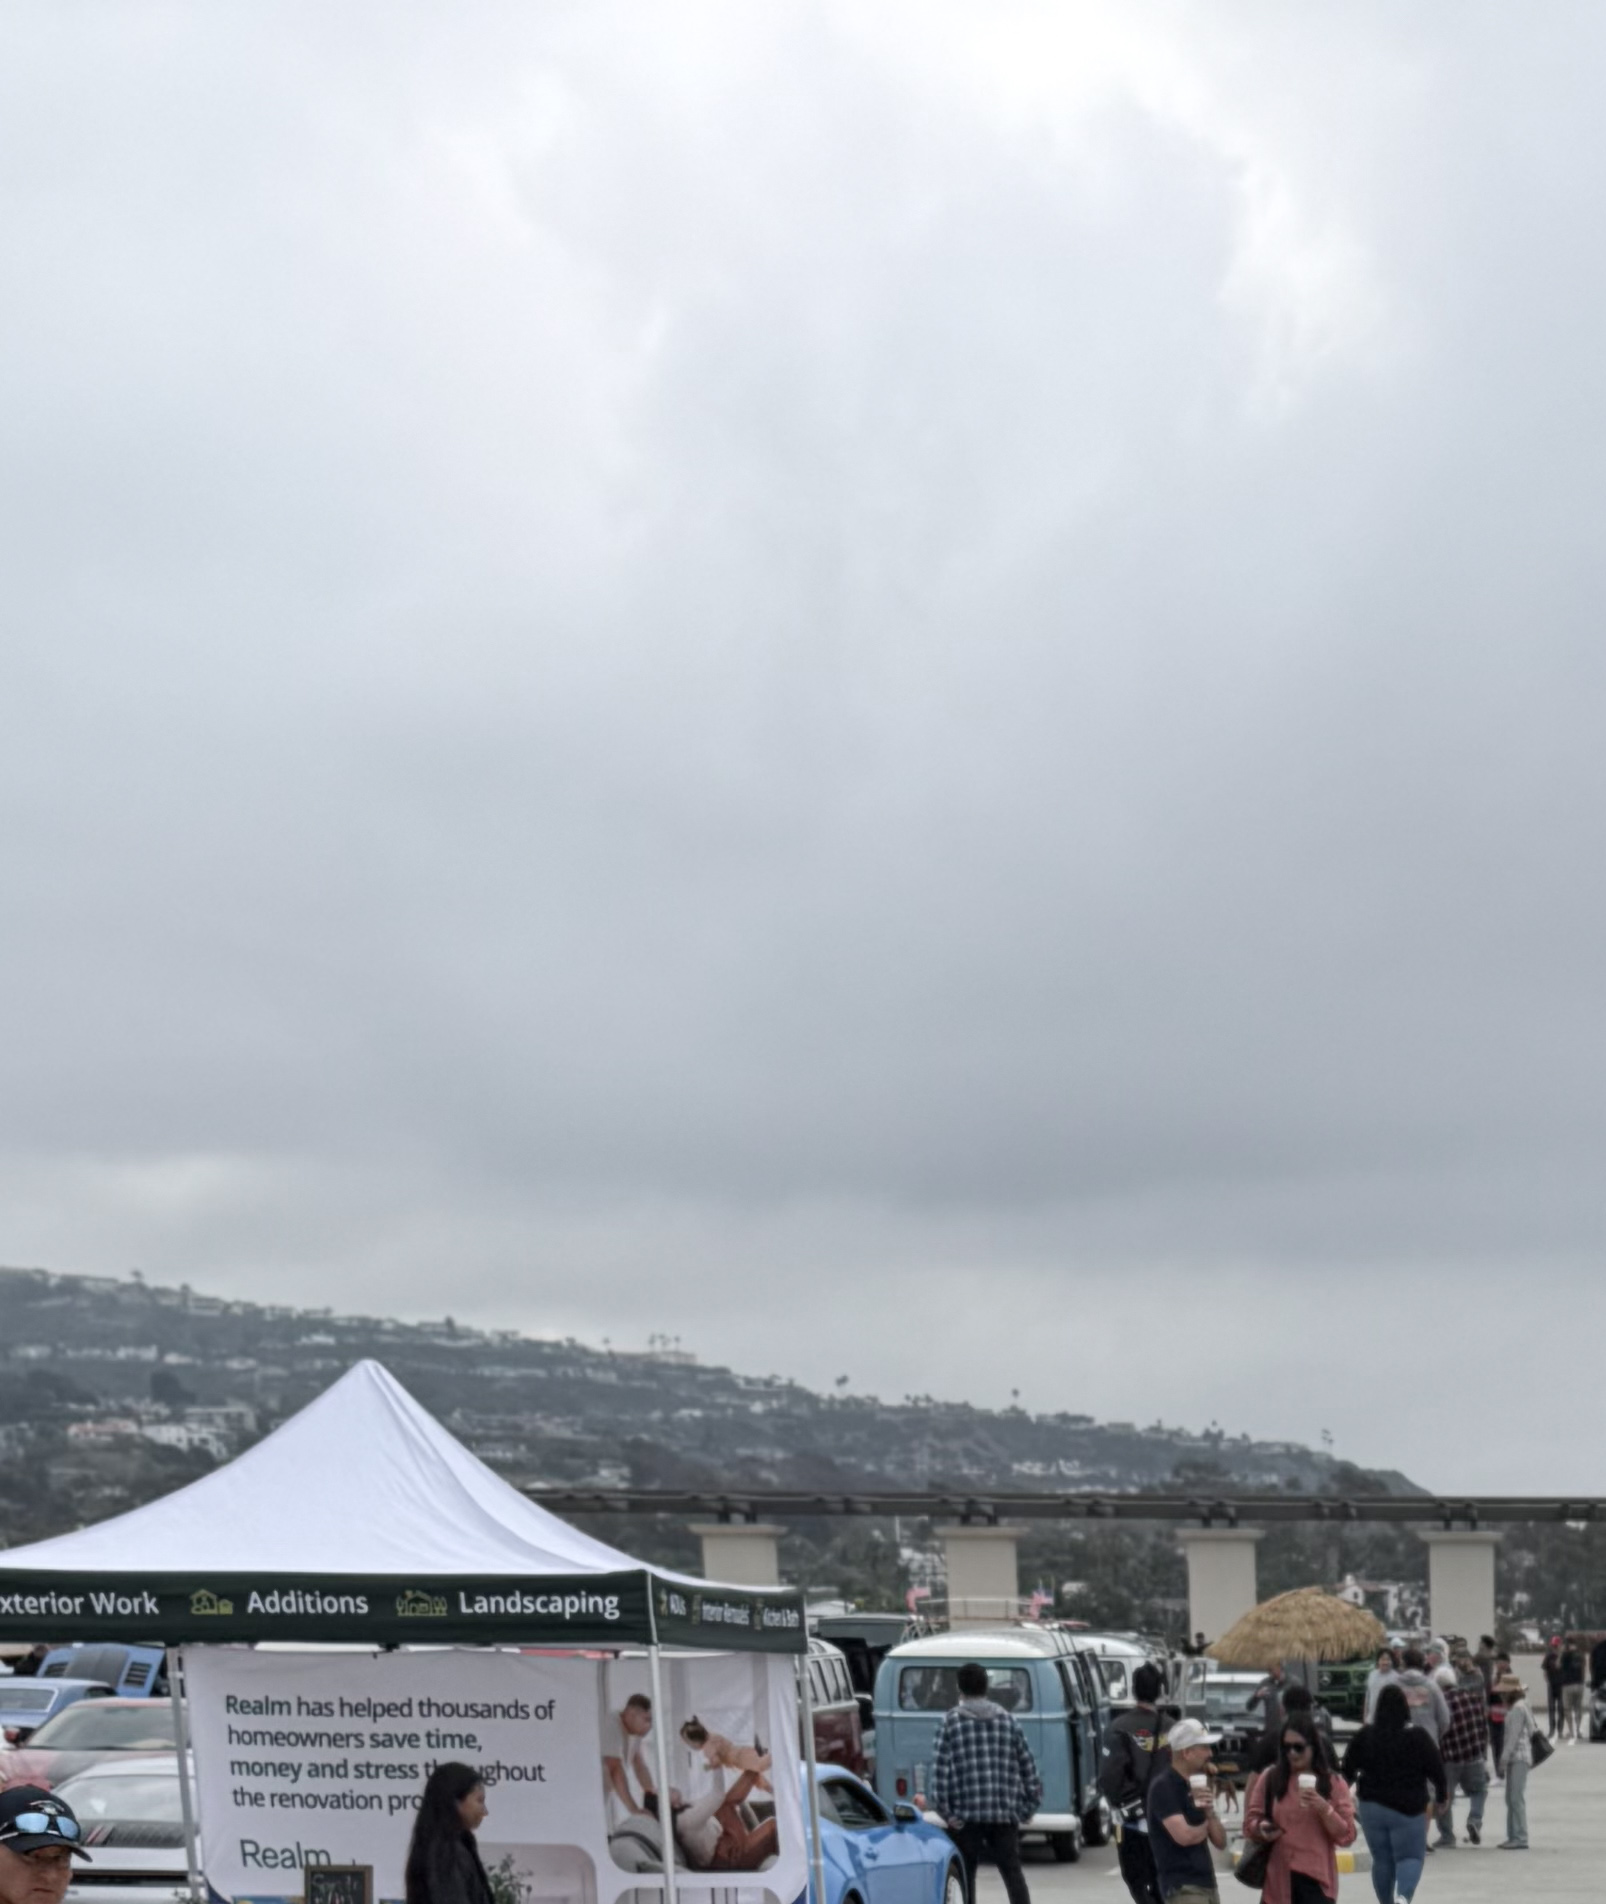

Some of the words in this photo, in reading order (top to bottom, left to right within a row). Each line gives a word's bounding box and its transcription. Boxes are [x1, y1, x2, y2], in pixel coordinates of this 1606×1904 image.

[0, 1591, 84, 1615] xterior
[89, 1592, 160, 1615] Work
[247, 1590, 369, 1615] Additions
[459, 1591, 620, 1620] Landscaping
[226, 1695, 292, 1716] Realm
[297, 1696, 335, 1717] has
[339, 1697, 413, 1724] helped
[418, 1698, 530, 1720] thousands
[534, 1699, 556, 1720] of
[228, 1725, 365, 1749] homeowners
[369, 1731, 421, 1749] save
[425, 1728, 483, 1752] time,
[230, 1759, 303, 1783] money
[307, 1758, 349, 1779] and
[353, 1761, 420, 1780] stress
[424, 1758, 547, 1787] tghout
[232, 1787, 265, 1807] the
[270, 1788, 382, 1810] renovation
[240, 1839, 332, 1870] Realm
